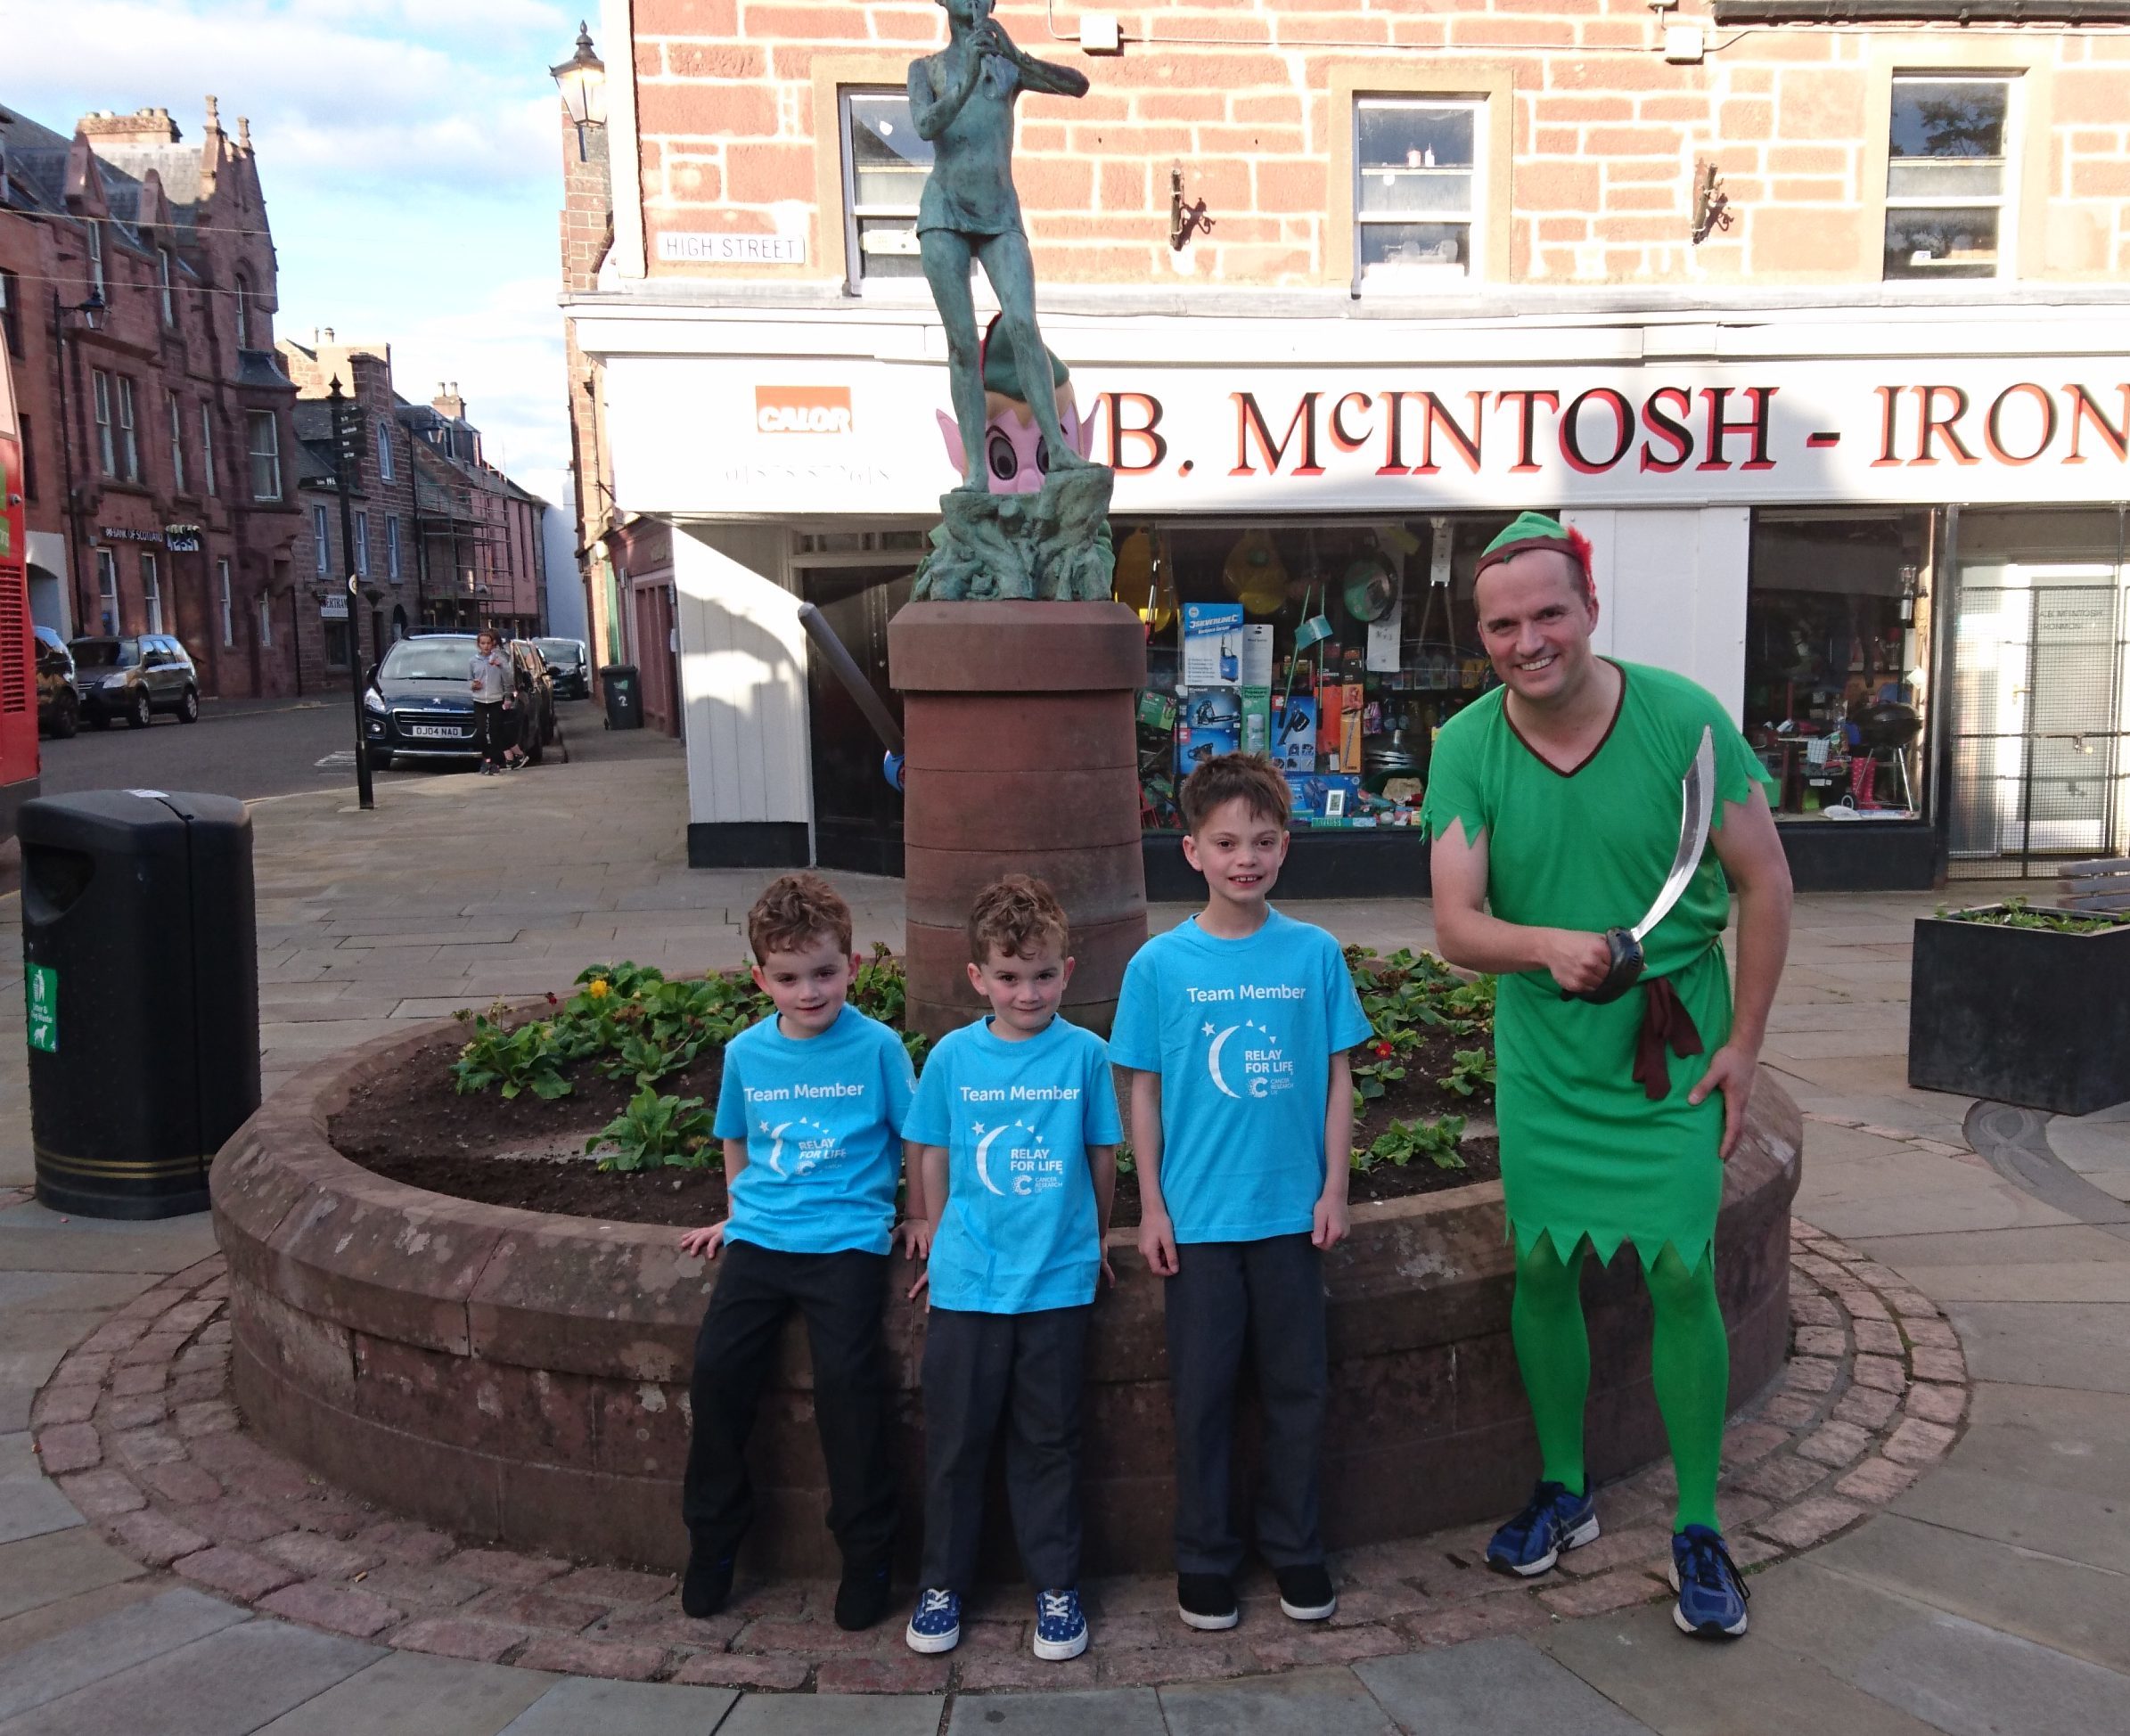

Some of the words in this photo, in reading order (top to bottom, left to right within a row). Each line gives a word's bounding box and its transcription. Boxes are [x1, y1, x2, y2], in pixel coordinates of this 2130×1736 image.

[667, 237, 712, 257] HIGH
[723, 238, 795, 258] STREET
[758, 406, 852, 432] CALOR
[1099, 390, 1194, 478] B.
[1806, 432, 1841, 447] -
[1869, 382, 2130, 468] IRON
[619, 695, 627, 707] 2
[1186, 987, 1234, 1003] Team
[1240, 984, 1306, 999] Member
[1245, 1049, 1282, 1060] RELAY
[1245, 1062, 1269, 1073] FOR
[1273, 1060, 1293, 1072] LIFE
[744, 1087, 790, 1102] Team
[794, 1083, 864, 1099] Member
[960, 1086, 1004, 1101] Team
[1010, 1085, 1080, 1101] Member
[799, 1138, 836, 1151] RELAY
[799, 1151, 821, 1159] FOR
[824, 1148, 847, 1159] LIFE
[1011, 1149, 1050, 1159] RELAY
[1010, 1160, 1035, 1171] FOR
[1038, 1160, 1063, 1171] LIFE
